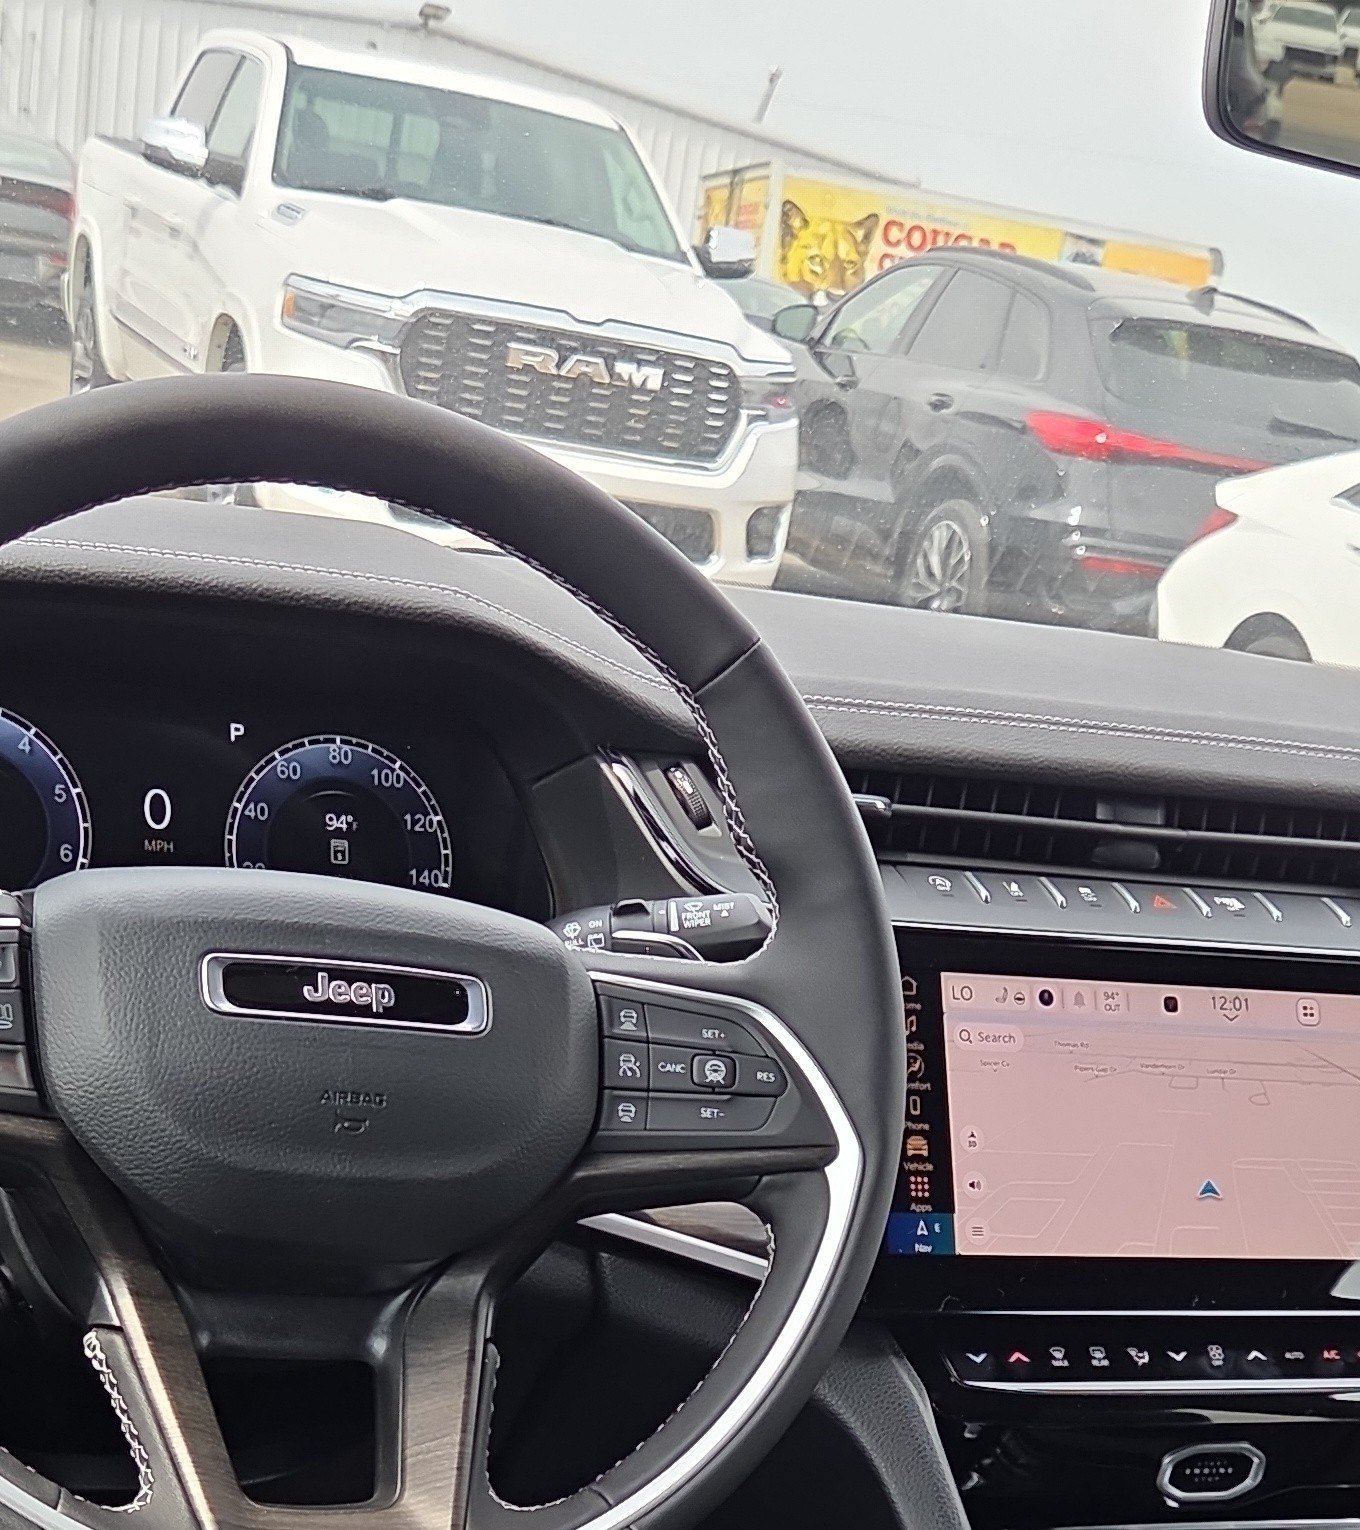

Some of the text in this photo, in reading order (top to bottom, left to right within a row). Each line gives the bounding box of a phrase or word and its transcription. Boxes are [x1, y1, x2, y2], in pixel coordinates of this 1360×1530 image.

[883, 219, 1017, 255] COU
[506, 342, 665, 391] RAM
[230, 723, 245, 742] P
[17, 736, 31, 754] 4
[329, 747, 353, 765] 80
[276, 761, 301, 780] 60
[370, 768, 405, 788] 100
[54, 784, 66, 803] 5
[143, 788, 172, 830] 0
[244, 802, 269, 821] 40
[403, 813, 437, 832] 120
[60, 844, 72, 862] 6
[143, 839, 174, 853] MPH
[409, 869, 443, 887] 140
[713, 902, 734, 911] MIST
[589, 919, 602, 929] ON
[681, 910, 711, 922] FRONT
[683, 917, 712, 928] WIPER
[303, 971, 395, 1013] Jeep
[951, 985, 973, 1001] LO
[1104, 1003, 1121, 1012] OUT
[1211, 996, 1249, 1012] 12:01
[701, 1029, 726, 1039] SET+
[977, 1031, 1017, 1046] Search
[658, 1062, 687, 1074] CANC
[756, 1071, 776, 1083] RES
[319, 1089, 388, 1108] AIRBAG
[903, 1161, 935, 1171] Vehicle
[909, 1202, 933, 1213] Apps
[914, 1242, 933, 1253] Nav
